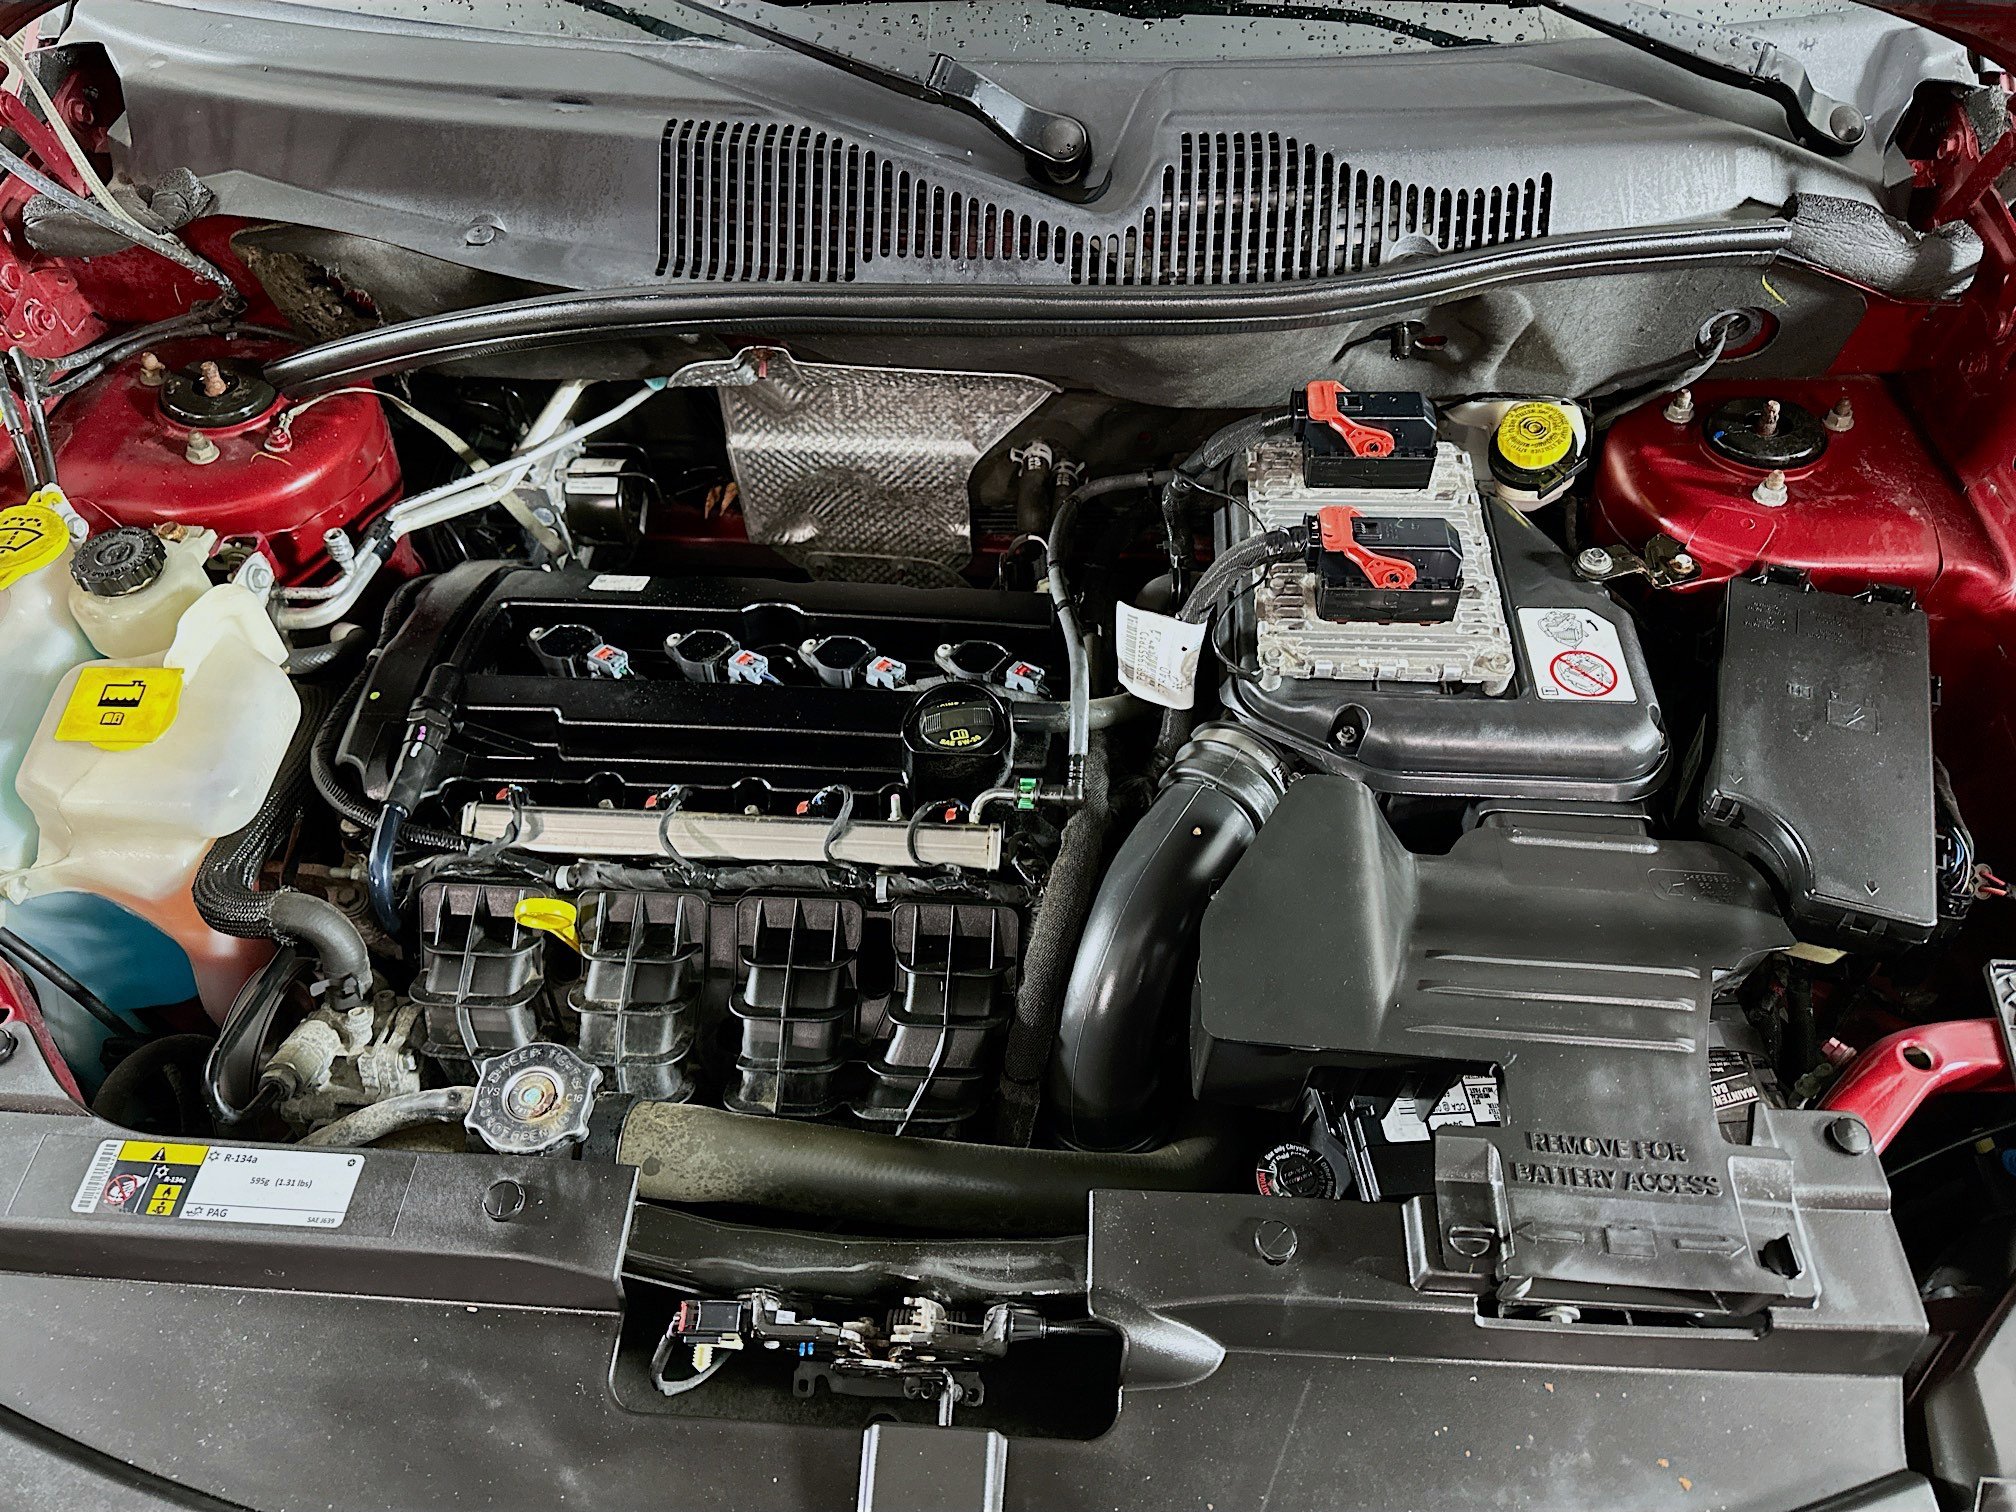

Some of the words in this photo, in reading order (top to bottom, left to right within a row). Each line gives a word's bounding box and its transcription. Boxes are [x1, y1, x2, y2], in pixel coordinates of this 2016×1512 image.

[939, 738, 955, 746] SAE
[501, 1047, 543, 1071] KEEP
[480, 1086, 501, 1097] TVS
[1712, 1086, 1758, 1107] MAINTEN
[566, 1093, 584, 1103] C16
[1451, 1102, 1467, 1111] CCA
[1274, 1145, 1286, 1153] only
[1286, 1143, 1310, 1154] Chrysler
[1525, 1132, 1631, 1159] REMOVE
[1637, 1140, 1689, 1162] FOR
[224, 1154, 258, 1164] R-134a
[250, 1176, 270, 1187] 595g
[275, 1177, 296, 1187] (1.31
[297, 1179, 313, 1189] lbs)
[1258, 1172, 1272, 1196] AUTION
[1510, 1162, 1617, 1190] BATTERY
[1624, 1170, 1724, 1197] ACCESS
[206, 1208, 229, 1218] PAG
